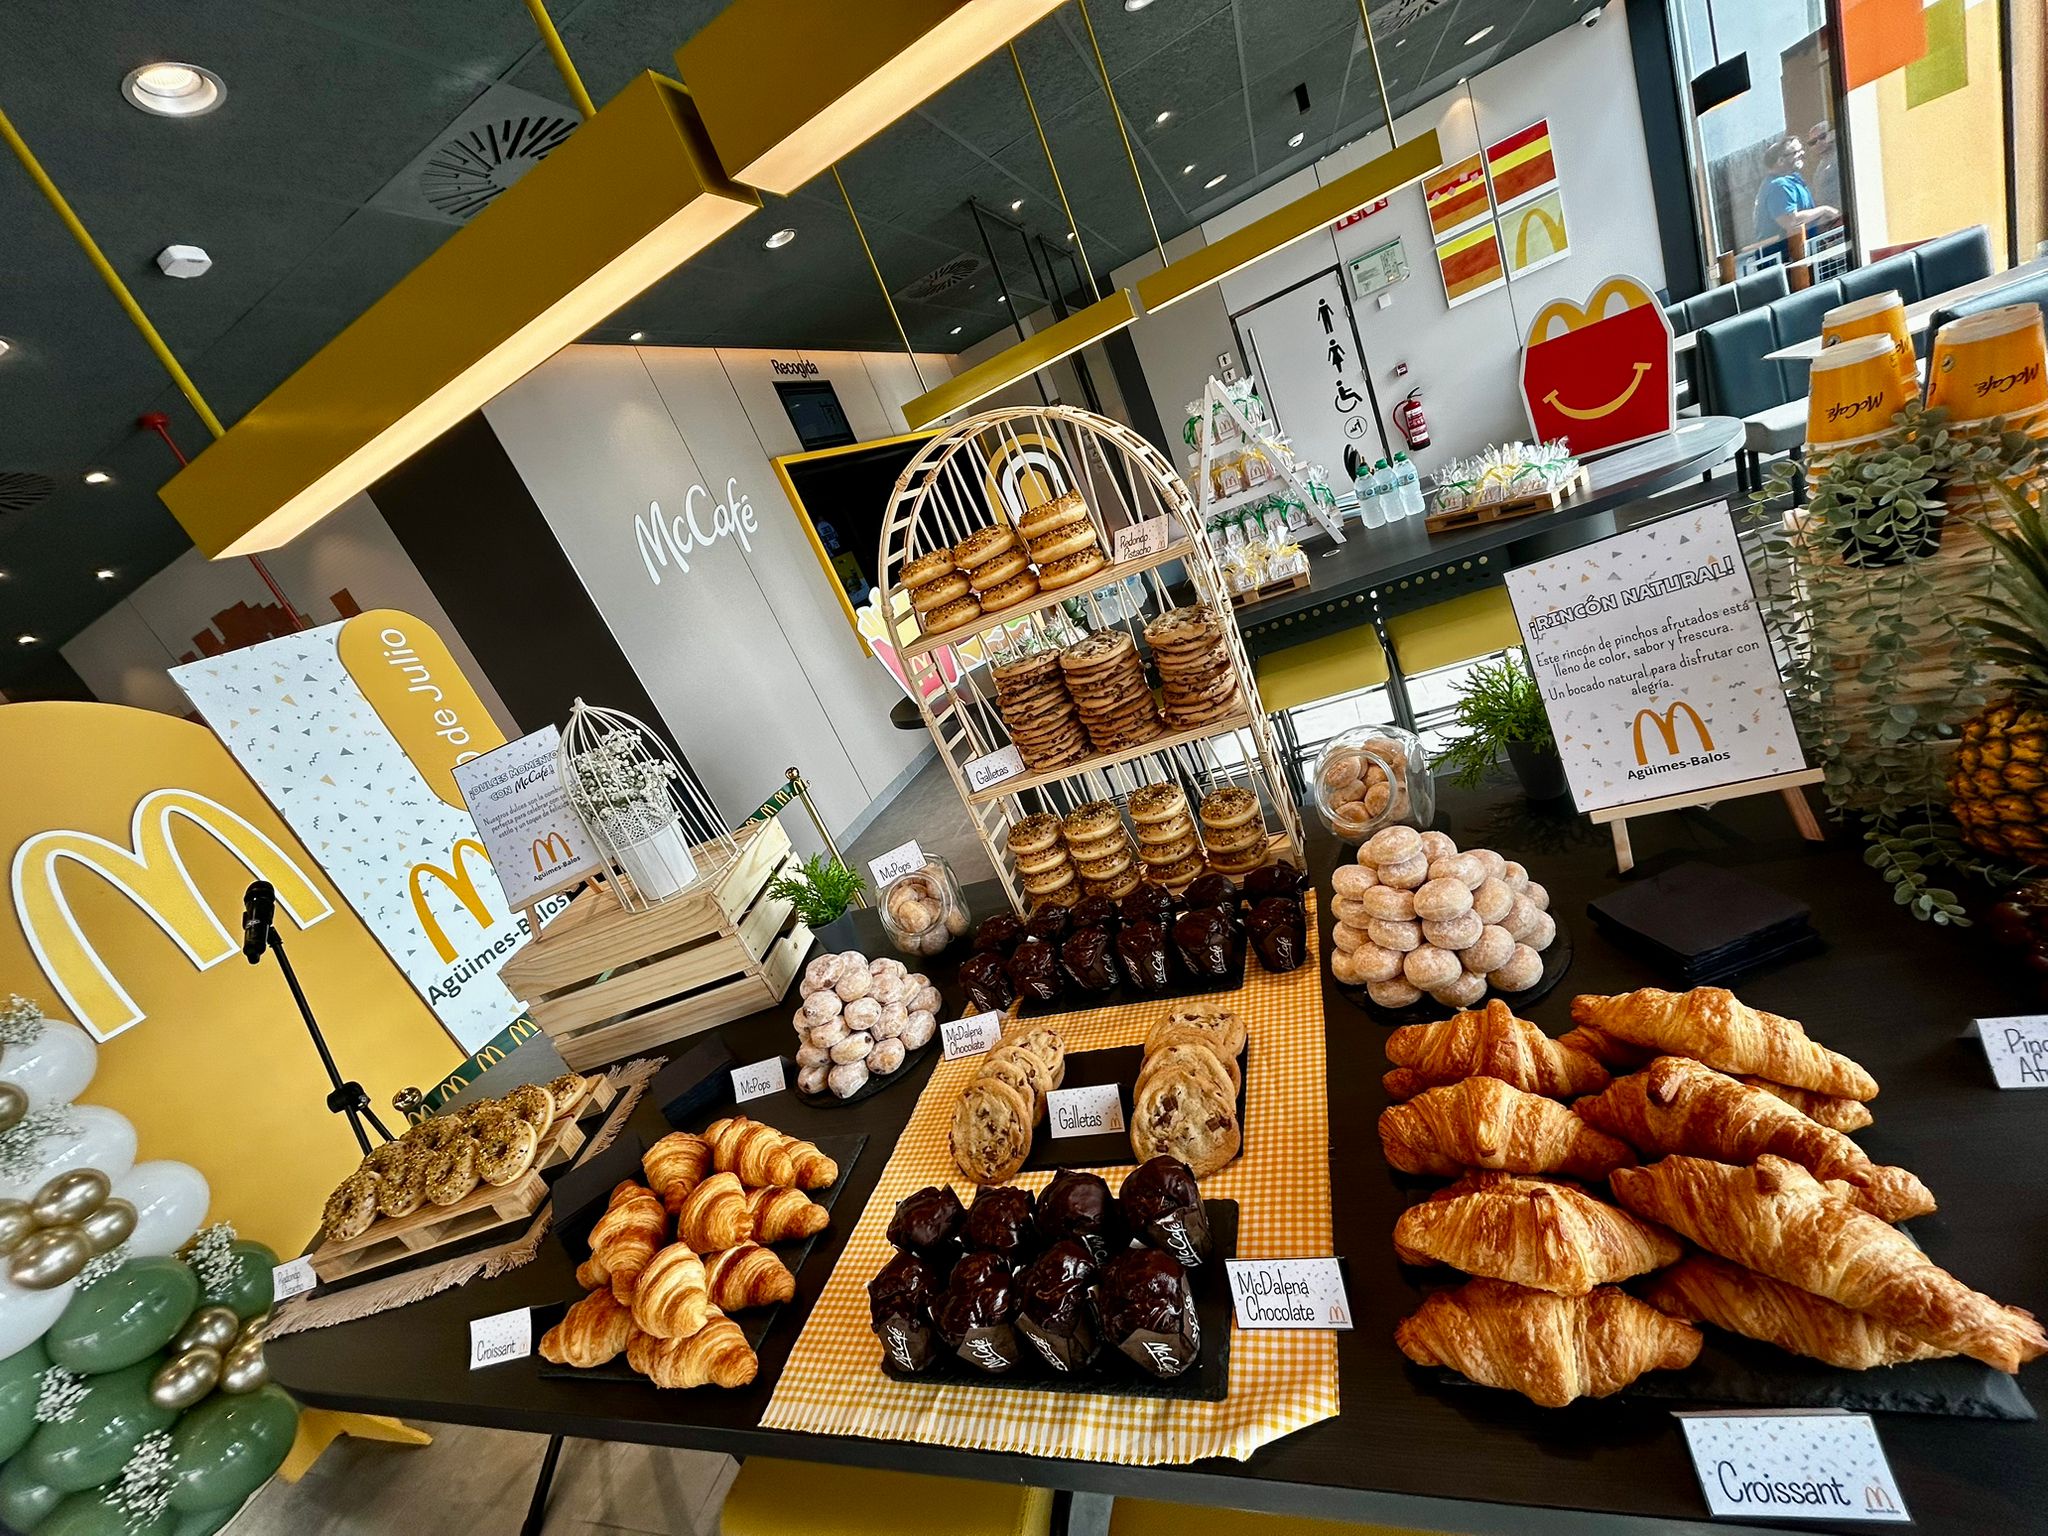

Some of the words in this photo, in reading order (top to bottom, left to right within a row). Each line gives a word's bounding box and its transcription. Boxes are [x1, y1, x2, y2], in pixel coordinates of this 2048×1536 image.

[771, 359, 819, 378] Recogida
[634, 477, 758, 585] McCafé
[1528, 593, 1619, 640] ¡RINCÓN
[1620, 555, 1736, 607] NATURAL!
[1535, 651, 1560, 667] Este
[1562, 644, 1596, 661] rincón
[1598, 635, 1612, 650] de
[1614, 625, 1659, 649] pinchos
[1661, 607, 1719, 633] afrutados
[1722, 600, 1750, 617] está
[1553, 662, 1581, 677] lleno
[1583, 655, 1596, 669] de
[1598, 648, 1631, 665] color,
[1633, 639, 1665, 657] sabor
[1667, 639, 1675, 650] y
[1677, 624, 1734, 644] frescura.
[380, 628, 443, 702] Julio
[1548, 687, 1566, 701] Un
[1565, 675, 1606, 697] bocado
[1607, 662, 1648, 686] natural
[1650, 662, 1677, 678] para
[1679, 647, 1733, 669] disfrutar
[1736, 642, 1760, 655] con
[1631, 679, 1674, 696] alegría.
[433, 708, 470, 745] de
[975, 765, 1010, 785] Galletas
[1626, 750, 1731, 781] Agüimes-Balos
[490, 785, 513, 801] CON
[533, 856, 581, 882] Agüimes-Balos
[879, 861, 911, 881] McPops
[740, 1077, 771, 1096] McPops
[1058, 1104, 1103, 1130] Galletas
[1236, 1268, 1310, 1296] McDalena
[1246, 1294, 1315, 1321] Chocolate
[476, 1339, 516, 1362] Croissant
[1717, 1460, 1852, 1506] Croissant
